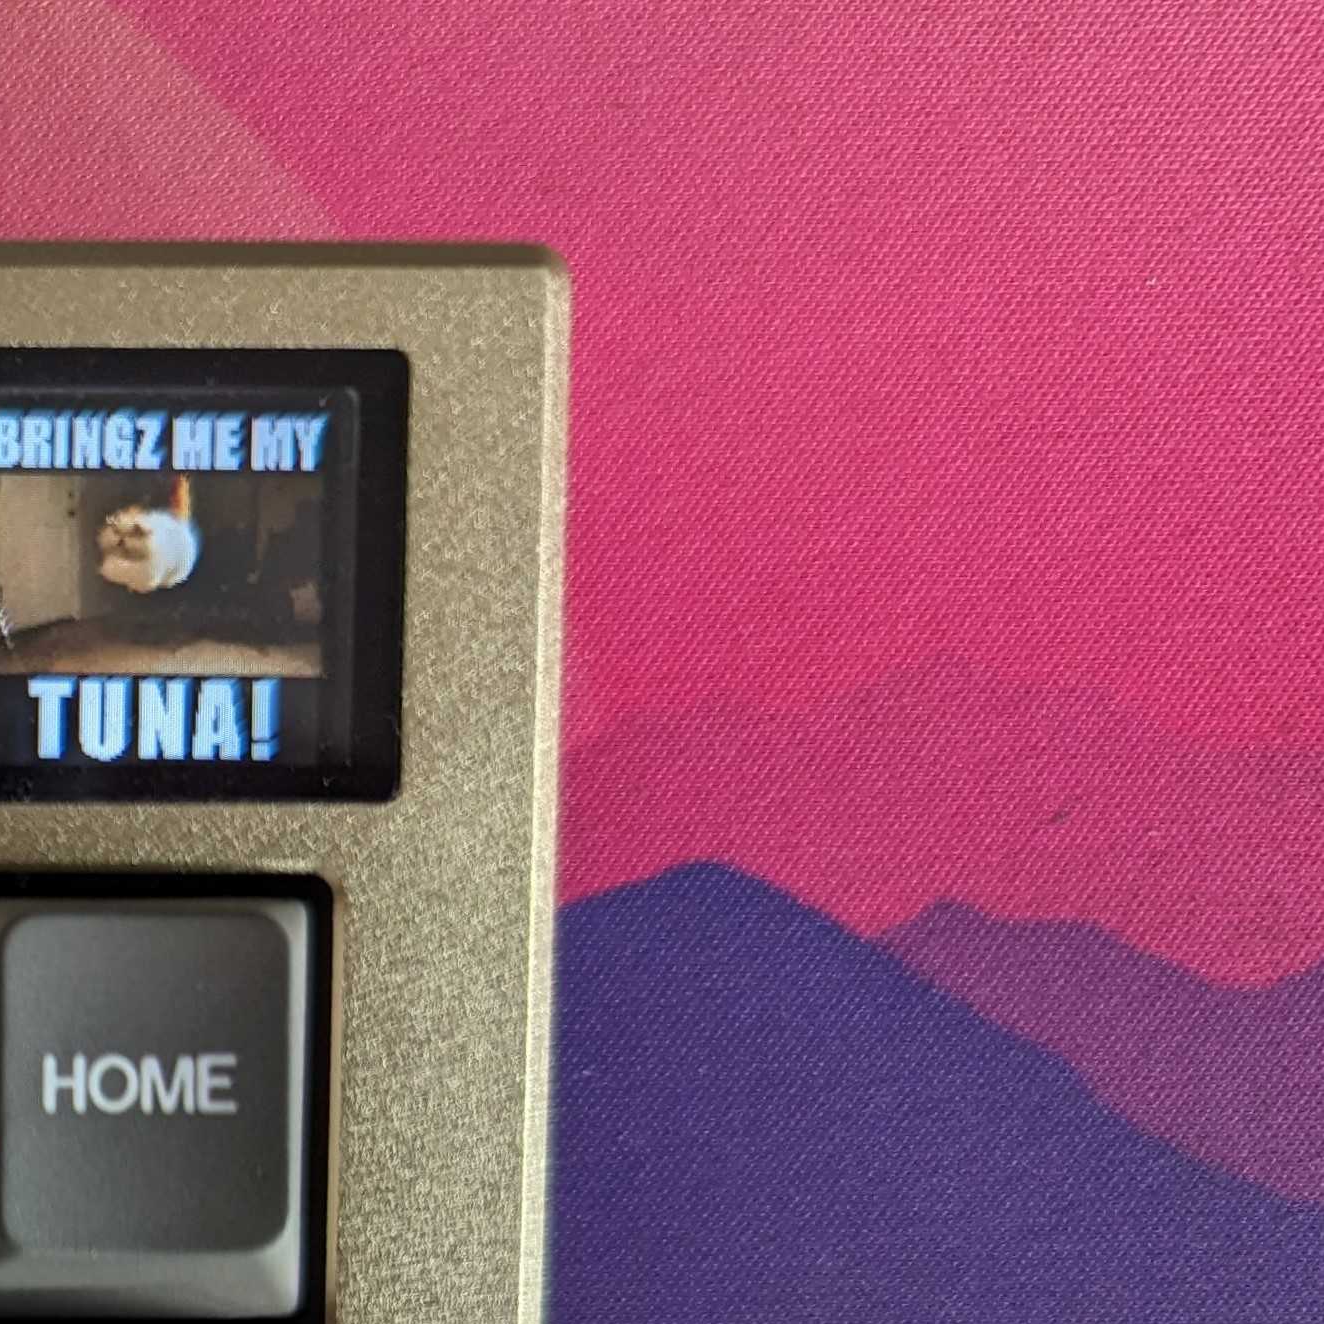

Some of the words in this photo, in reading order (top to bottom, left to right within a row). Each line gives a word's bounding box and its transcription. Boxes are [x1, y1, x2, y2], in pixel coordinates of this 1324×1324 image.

[171, 410, 249, 471] ME
[250, 410, 330, 473] MY
[27, 676, 281, 763] TUNA!
[41, 1053, 238, 1116] HOME
